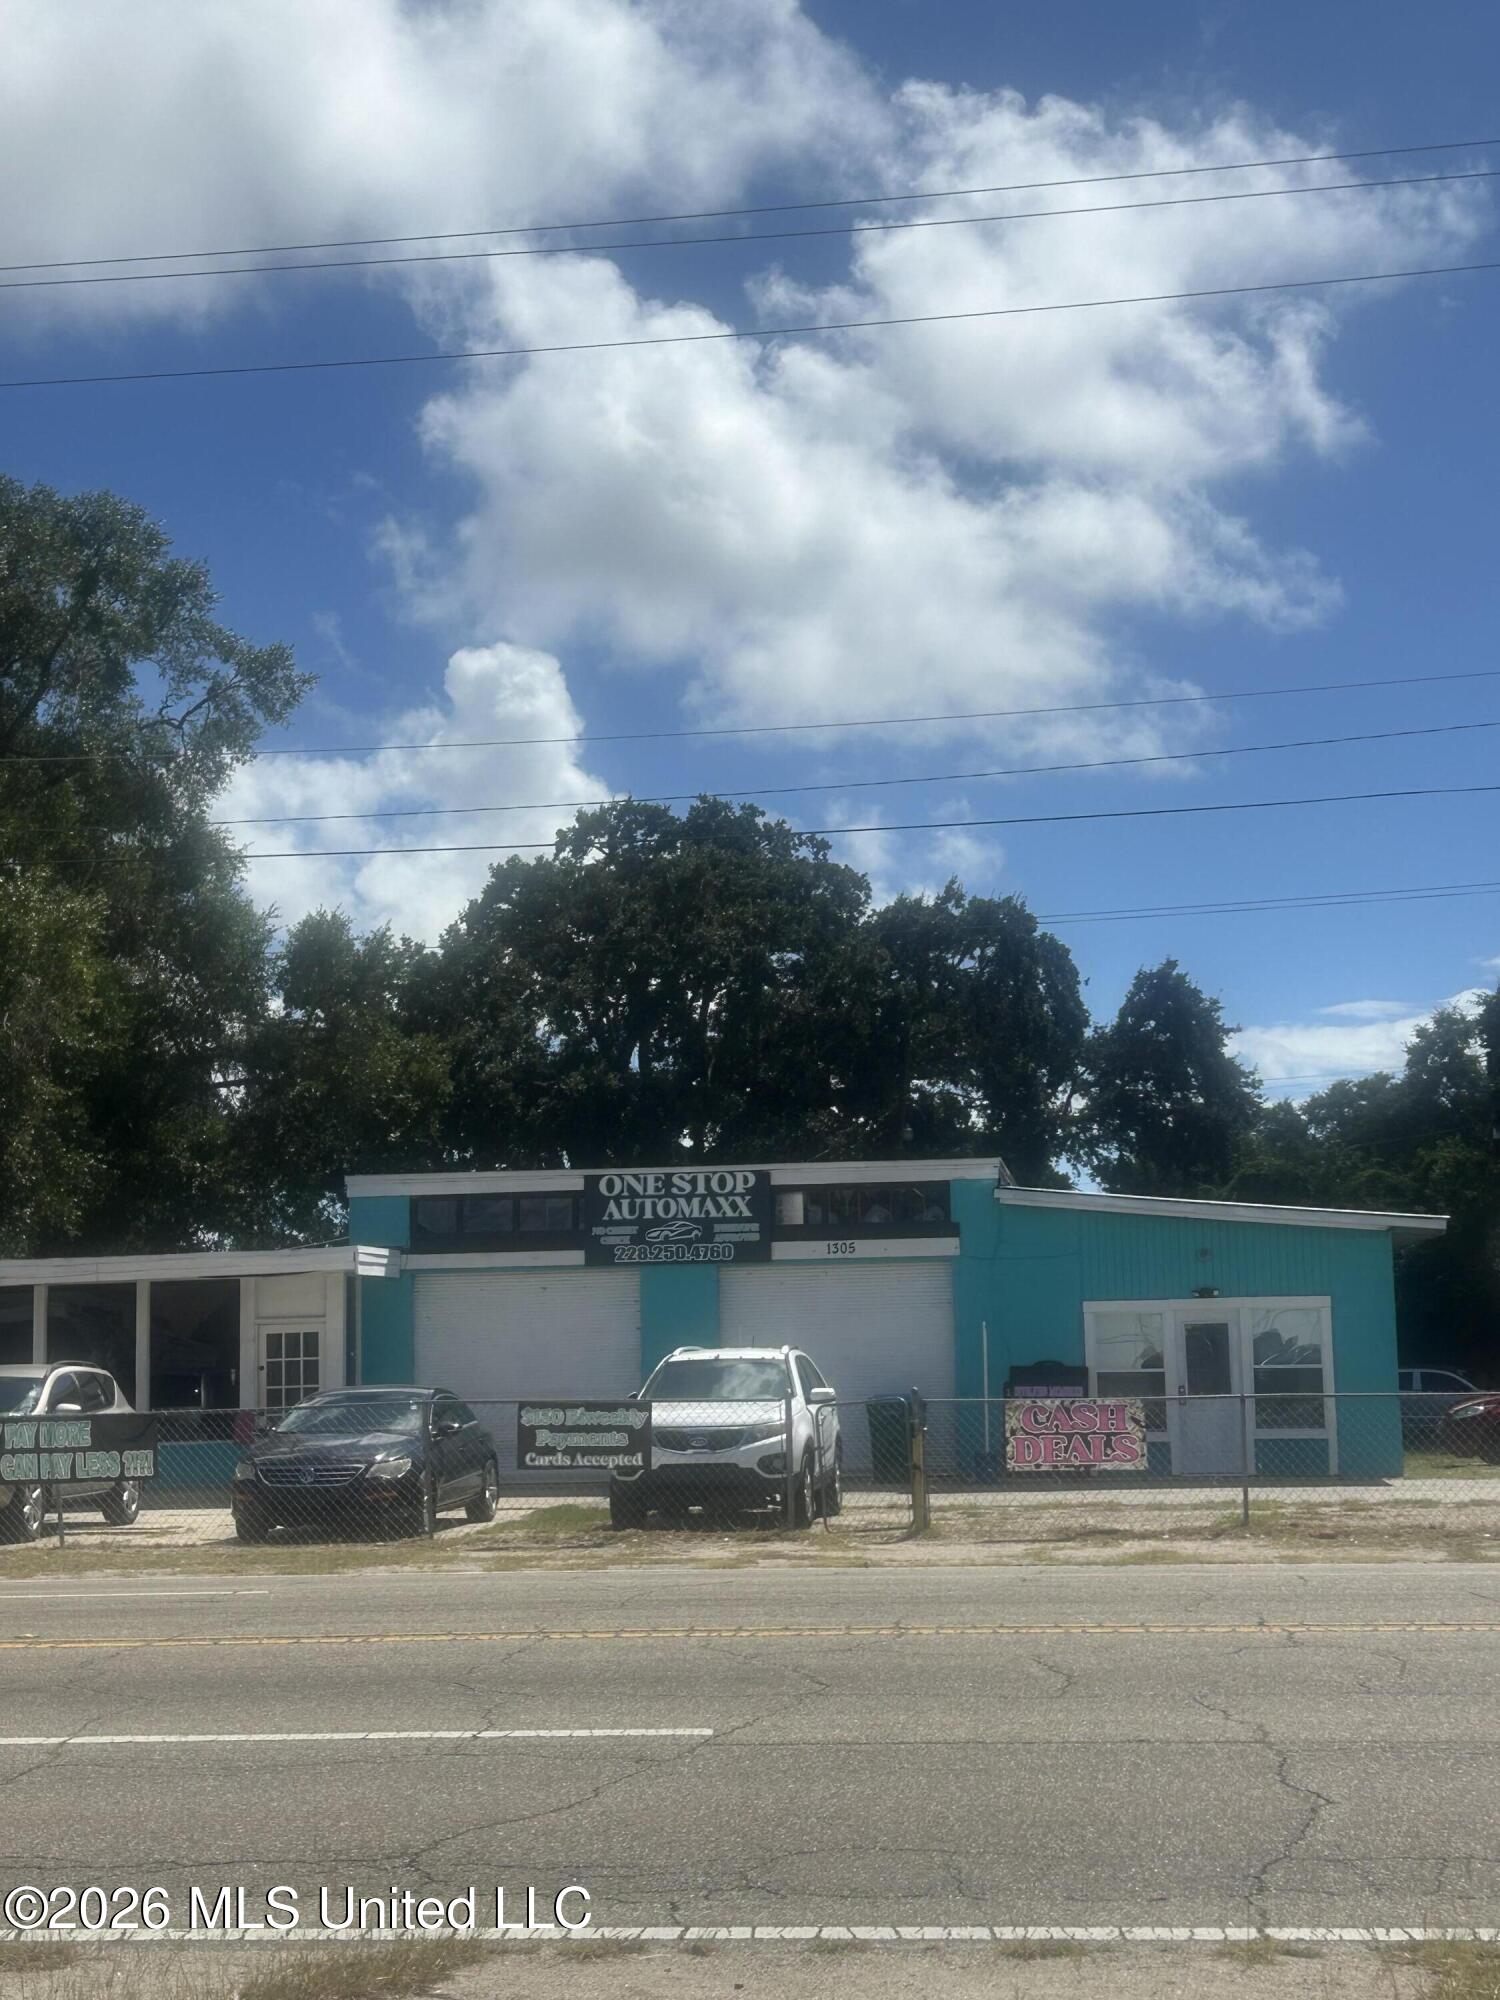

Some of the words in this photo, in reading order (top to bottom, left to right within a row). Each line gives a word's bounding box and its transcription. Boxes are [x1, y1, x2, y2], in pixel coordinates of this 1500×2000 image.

[599, 1174, 665, 1196] ONE
[671, 1172, 756, 1195] STOP
[602, 1196, 752, 1220] AUTOMAXX
[826, 1242, 856, 1255] 1305
[1020, 1403, 1128, 1433] CASH
[4, 1422, 38, 1449] PAY
[39, 1420, 92, 1448] MORE
[525, 1451, 571, 1466] Cards
[573, 1452, 644, 1468] Accepted
[1011, 1434, 1140, 1465] DEALS
[0, 1453, 38, 1481] CAN
[39, 1452, 73, 1480] PAY
[75, 1450, 121, 1479] LESS
